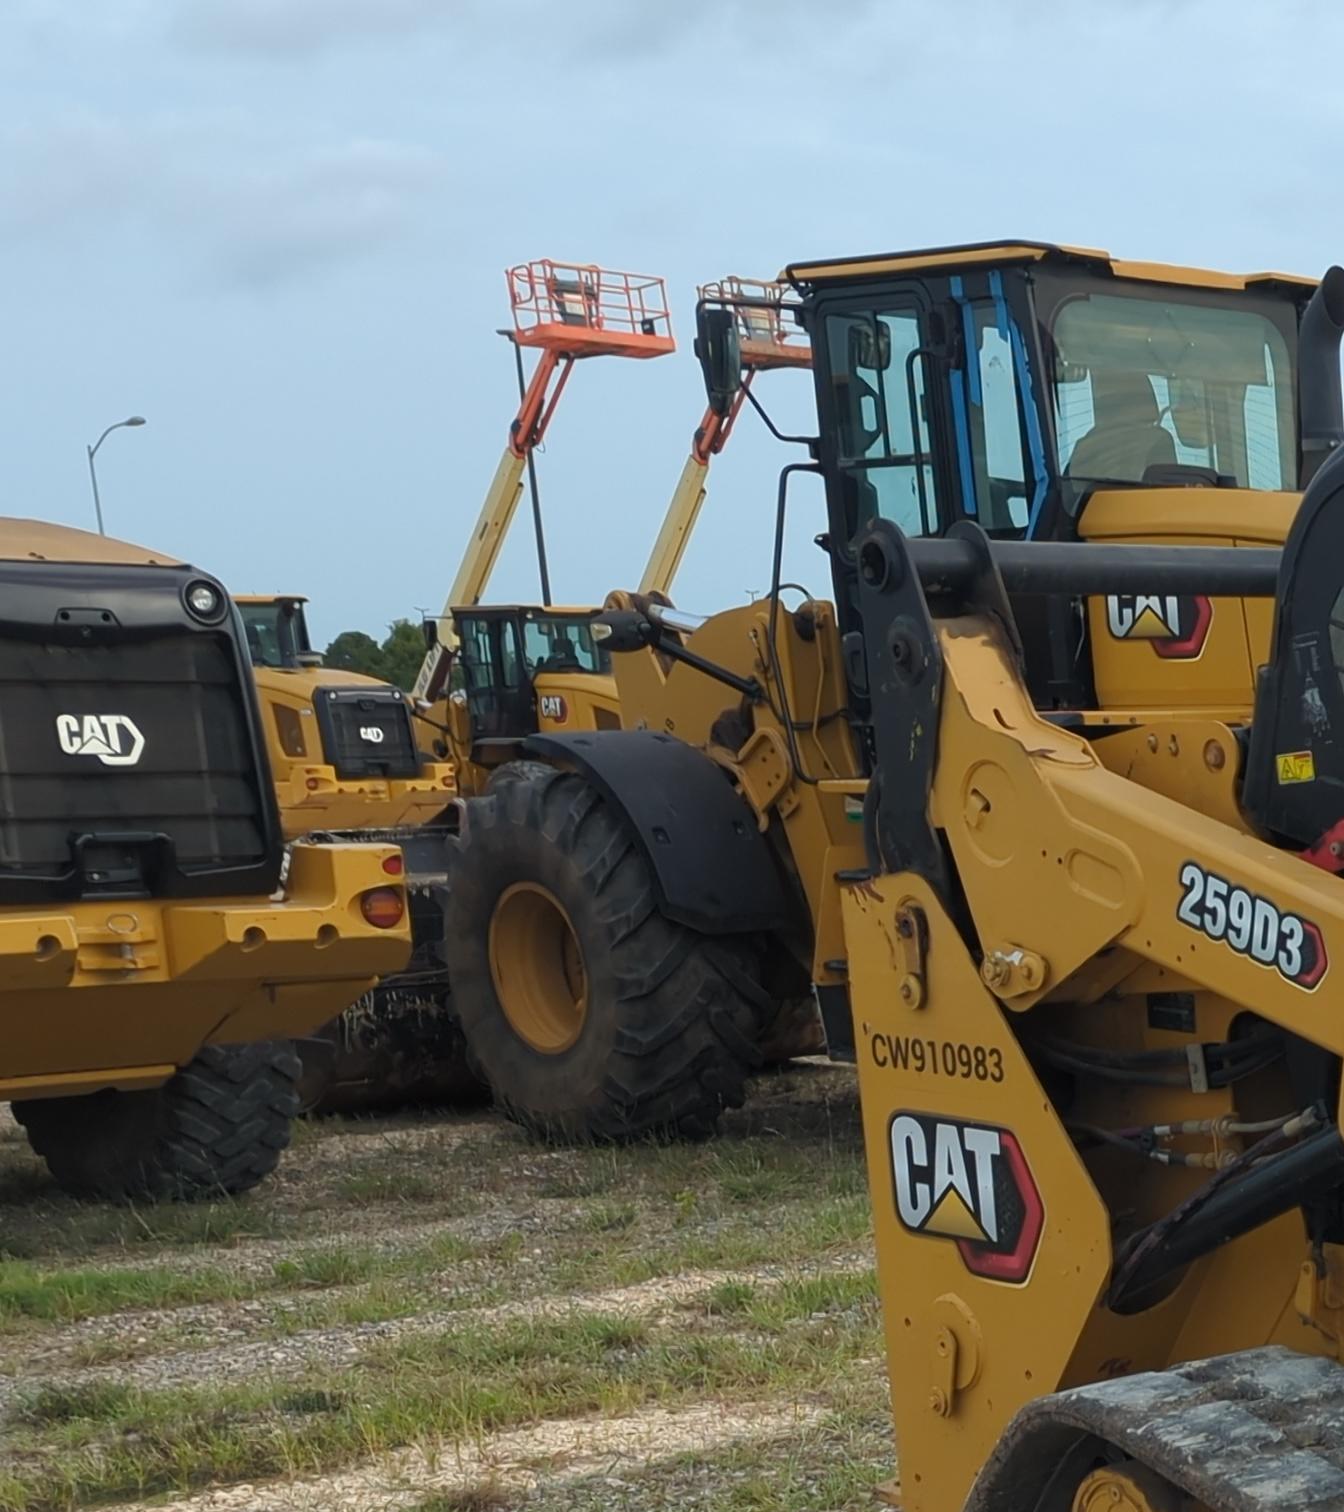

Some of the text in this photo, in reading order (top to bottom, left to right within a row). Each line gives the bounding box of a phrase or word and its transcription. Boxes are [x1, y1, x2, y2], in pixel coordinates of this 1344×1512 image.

[541, 697, 561, 716] CAT
[56, 714, 122, 755] CAT
[1178, 864, 1304, 977] 259D3
[871, 1032, 1005, 1083] CW910983
[891, 1115, 1001, 1243] CAT
